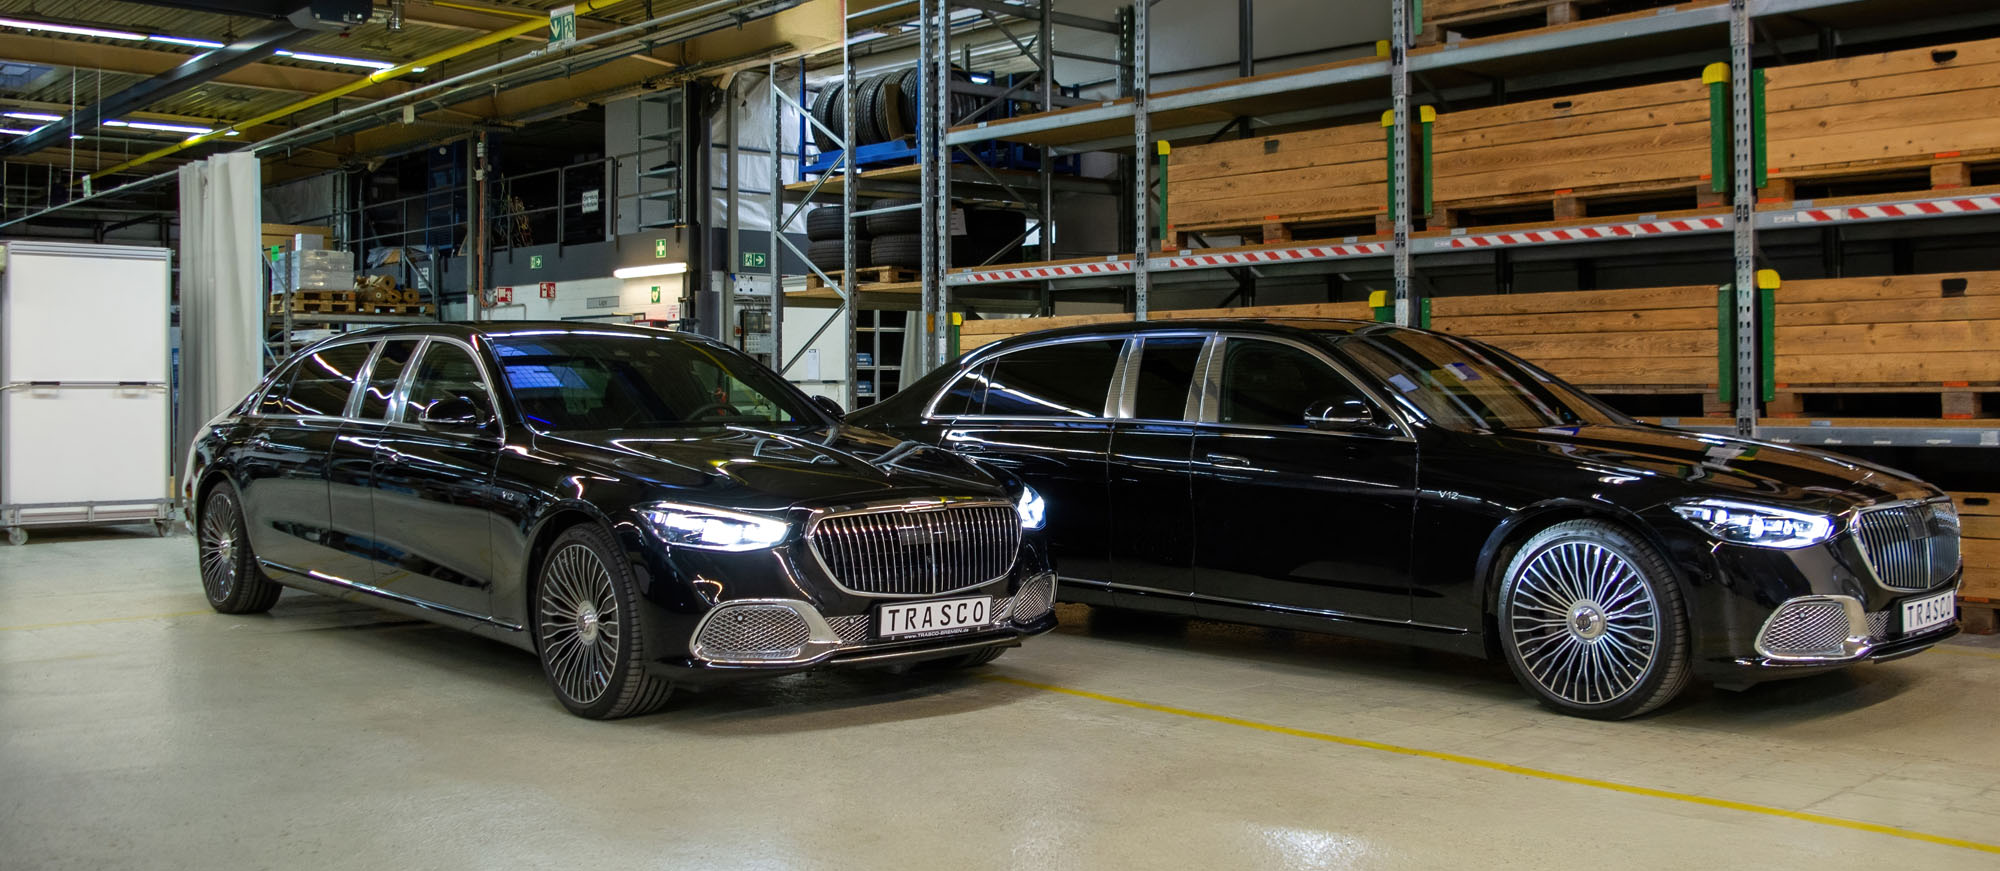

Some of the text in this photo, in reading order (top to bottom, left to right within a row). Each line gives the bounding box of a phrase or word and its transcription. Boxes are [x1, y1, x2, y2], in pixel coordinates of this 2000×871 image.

[1439, 490, 1459, 500] V12
[888, 600, 984, 632] TRASCO
[1907, 594, 1952, 628] TRASCO
